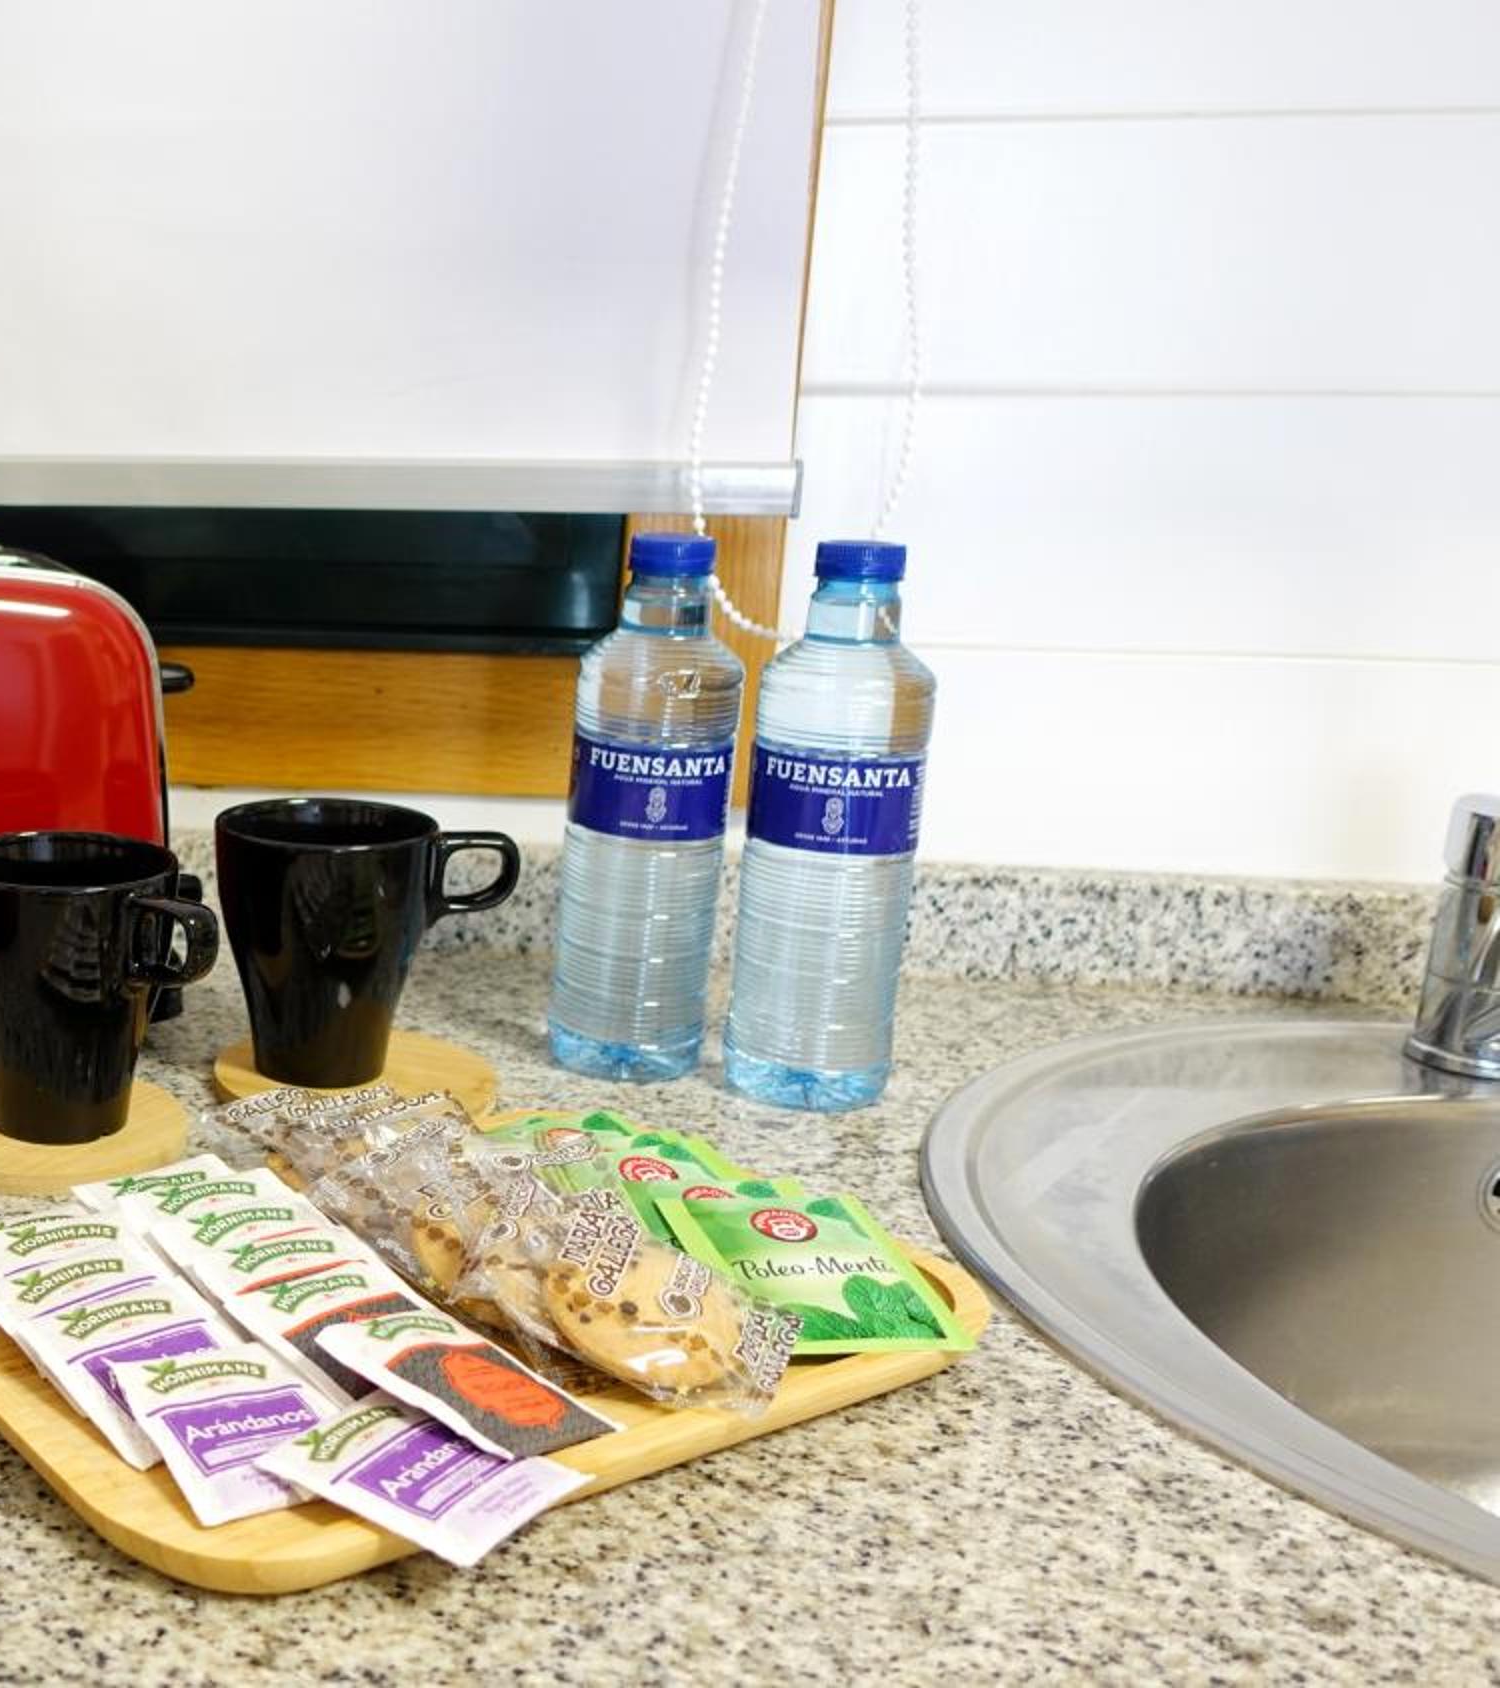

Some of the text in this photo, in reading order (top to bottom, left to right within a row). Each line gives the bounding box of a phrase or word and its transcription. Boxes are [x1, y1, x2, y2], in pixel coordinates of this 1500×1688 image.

[589, 747, 725, 777] FUENSANTA
[765, 757, 911, 788] FUENSANTA
[163, 1182, 252, 1212] HORNIMANS
[13, 1226, 112, 1255] HORNIMANS
[199, 1209, 291, 1242] HORNIMANS
[561, 1210, 606, 1266] MARIA
[238, 1241, 332, 1270] HORNIMANS
[589, 1215, 638, 1296] GALLEGA
[22, 1261, 120, 1301] HORNIMANS
[277, 1276, 362, 1310] HORNIMANS
[69, 1302, 166, 1337] HORNIMANS
[152, 1362, 261, 1392] HORNIMANS
[186, 1410, 312, 1445] Arándanos
[379, 1440, 464, 1500] Arándan
